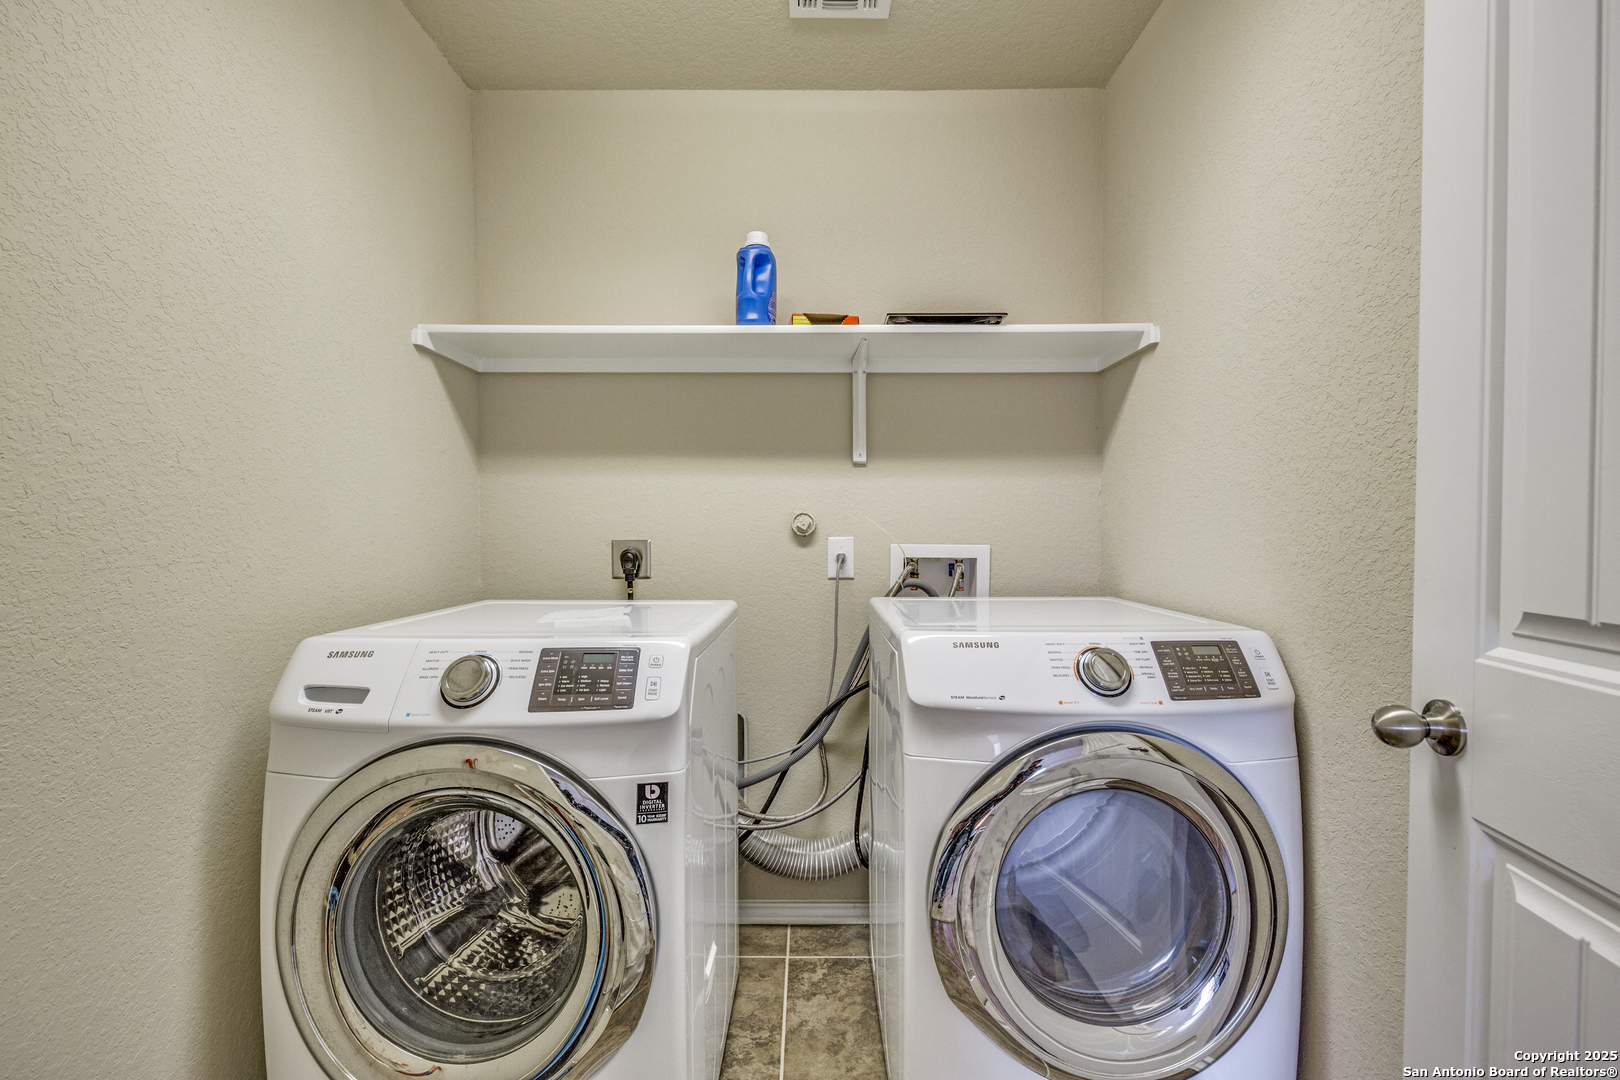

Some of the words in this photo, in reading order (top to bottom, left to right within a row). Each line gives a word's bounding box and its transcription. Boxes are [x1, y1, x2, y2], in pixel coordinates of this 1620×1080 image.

[952, 641, 1000, 649] SAMSUNG
[327, 650, 375, 659] SAMSUNG
[637, 814, 647, 823] 10
